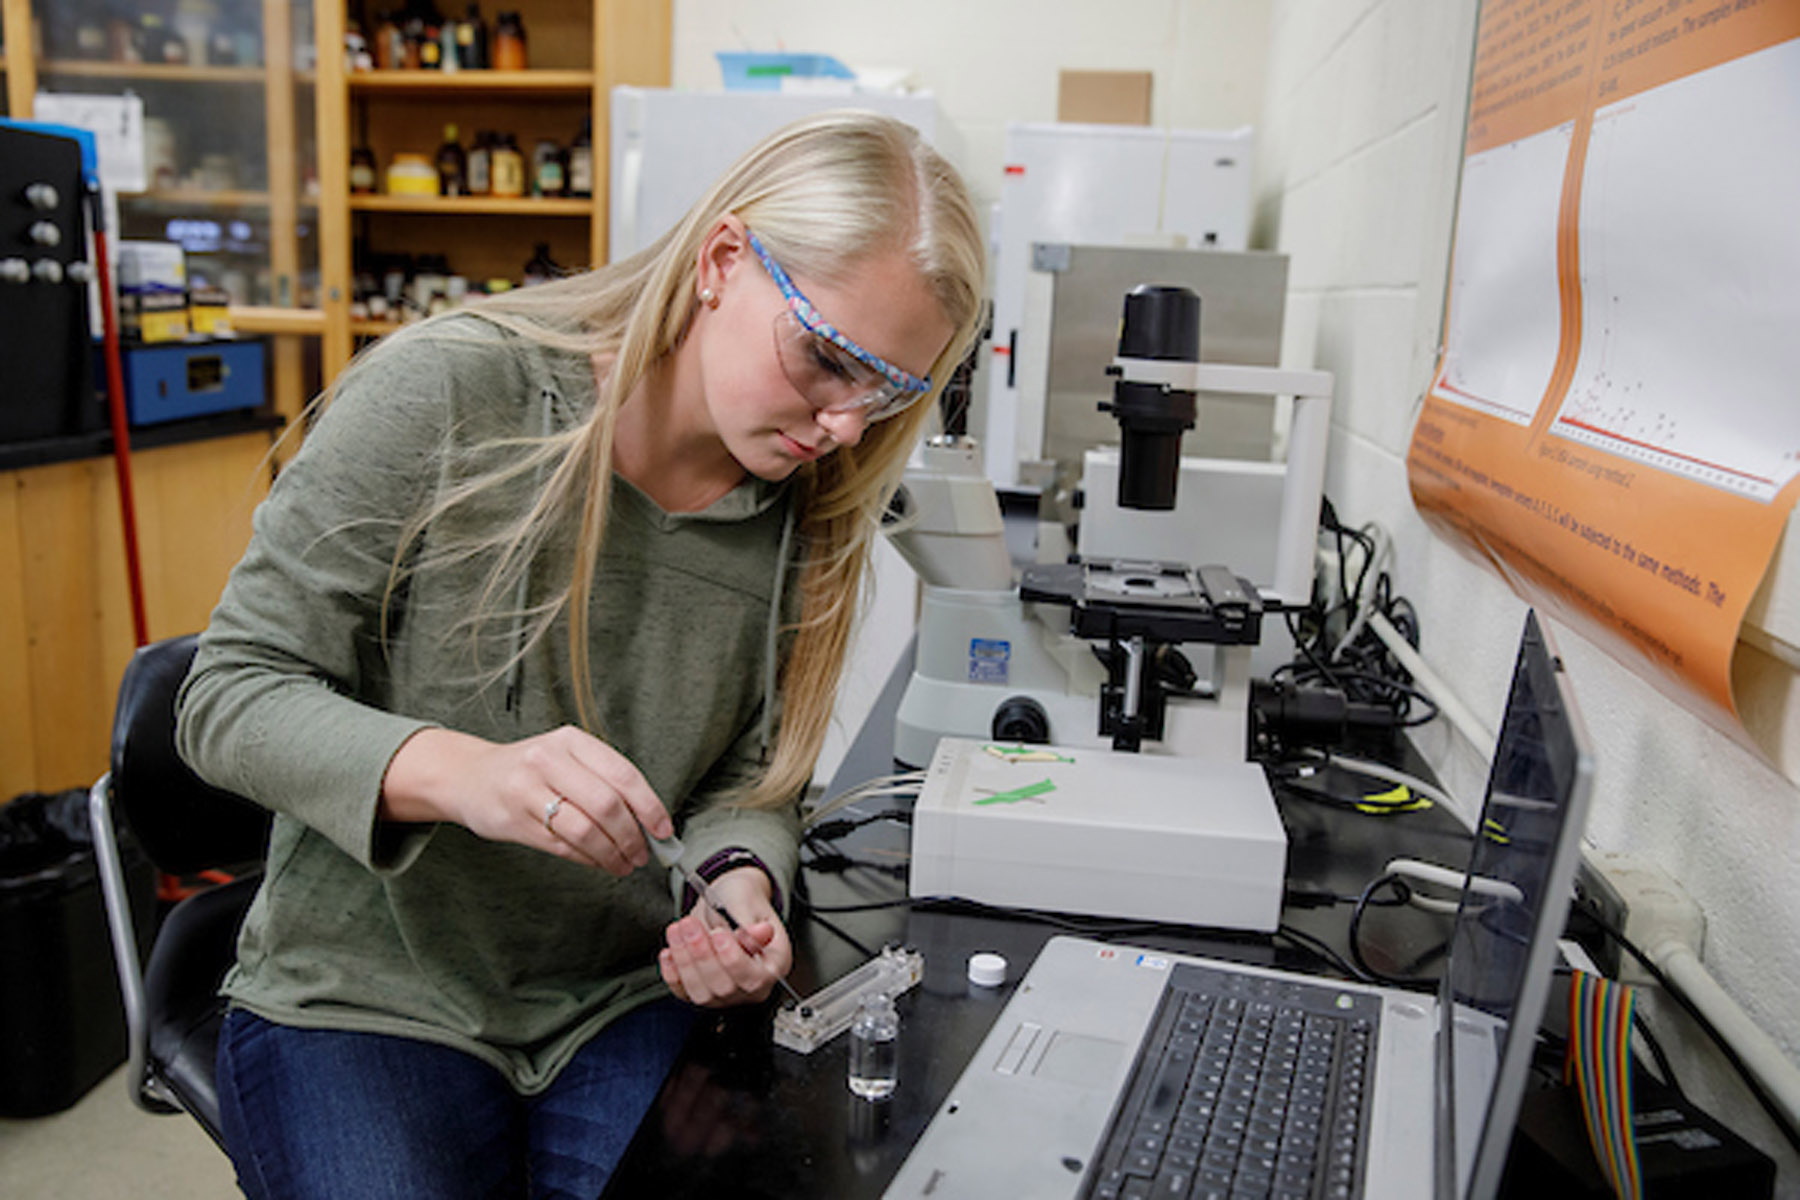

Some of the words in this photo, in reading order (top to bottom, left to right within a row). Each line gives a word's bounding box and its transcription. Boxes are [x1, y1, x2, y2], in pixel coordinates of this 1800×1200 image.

[1622, 541, 1636, 562] the
[1637, 551, 1660, 576] same
[1705, 581, 1726, 608] The
